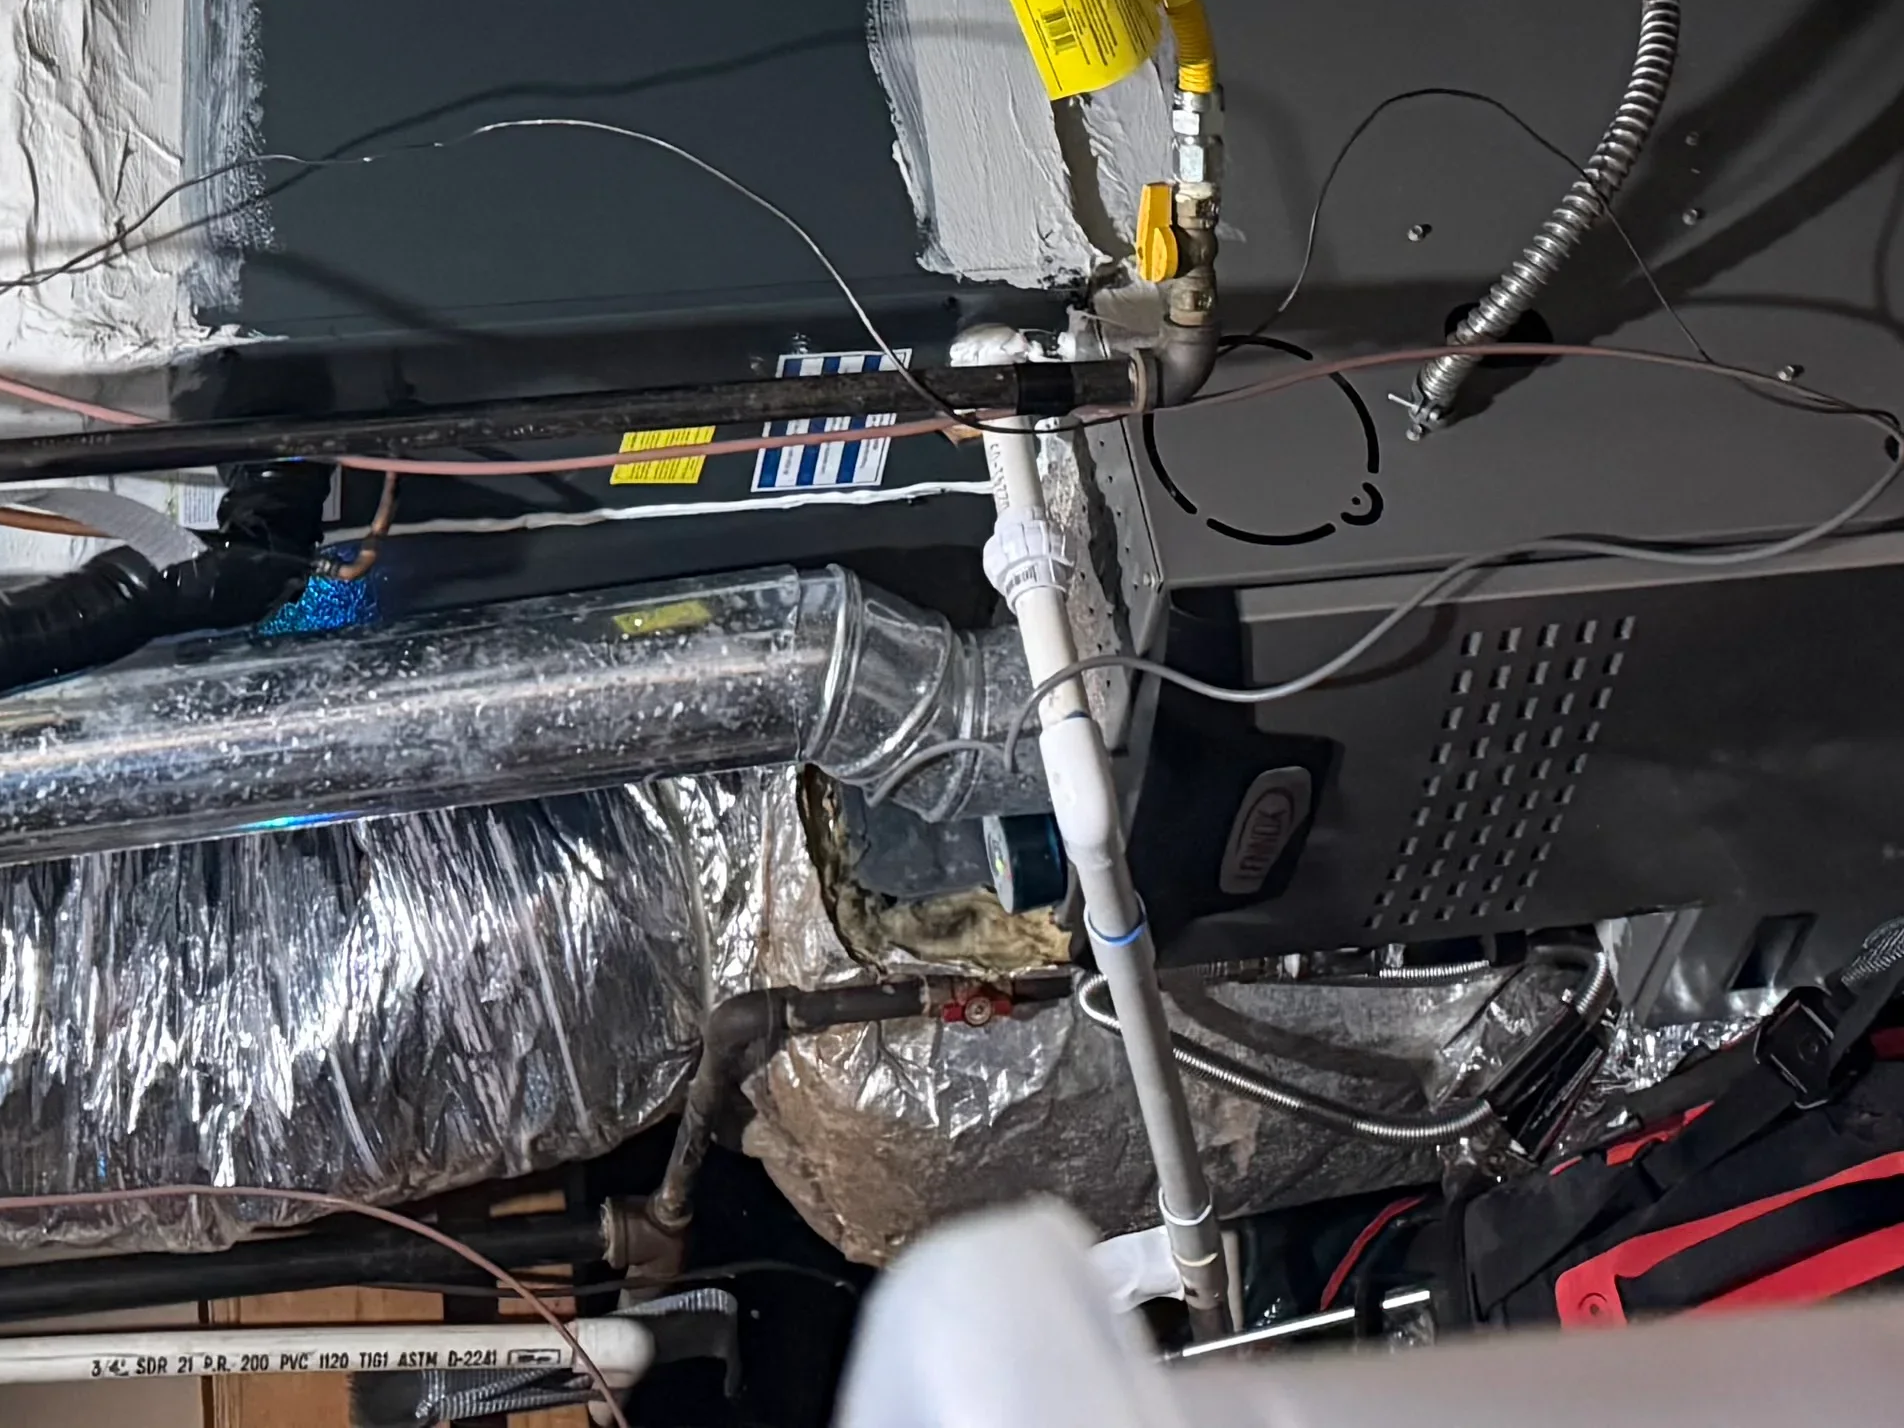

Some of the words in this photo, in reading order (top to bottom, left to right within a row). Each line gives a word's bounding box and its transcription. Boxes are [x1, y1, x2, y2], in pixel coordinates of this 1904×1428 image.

[136, 1355, 167, 1374] SDR
[177, 1356, 193, 1373] 21
[240, 1353, 269, 1371] 200
[279, 1352, 309, 1370] PVC
[319, 1351, 349, 1370] 1120
[398, 1351, 438, 1367] ASTM
[448, 1349, 497, 1367] D-2241
